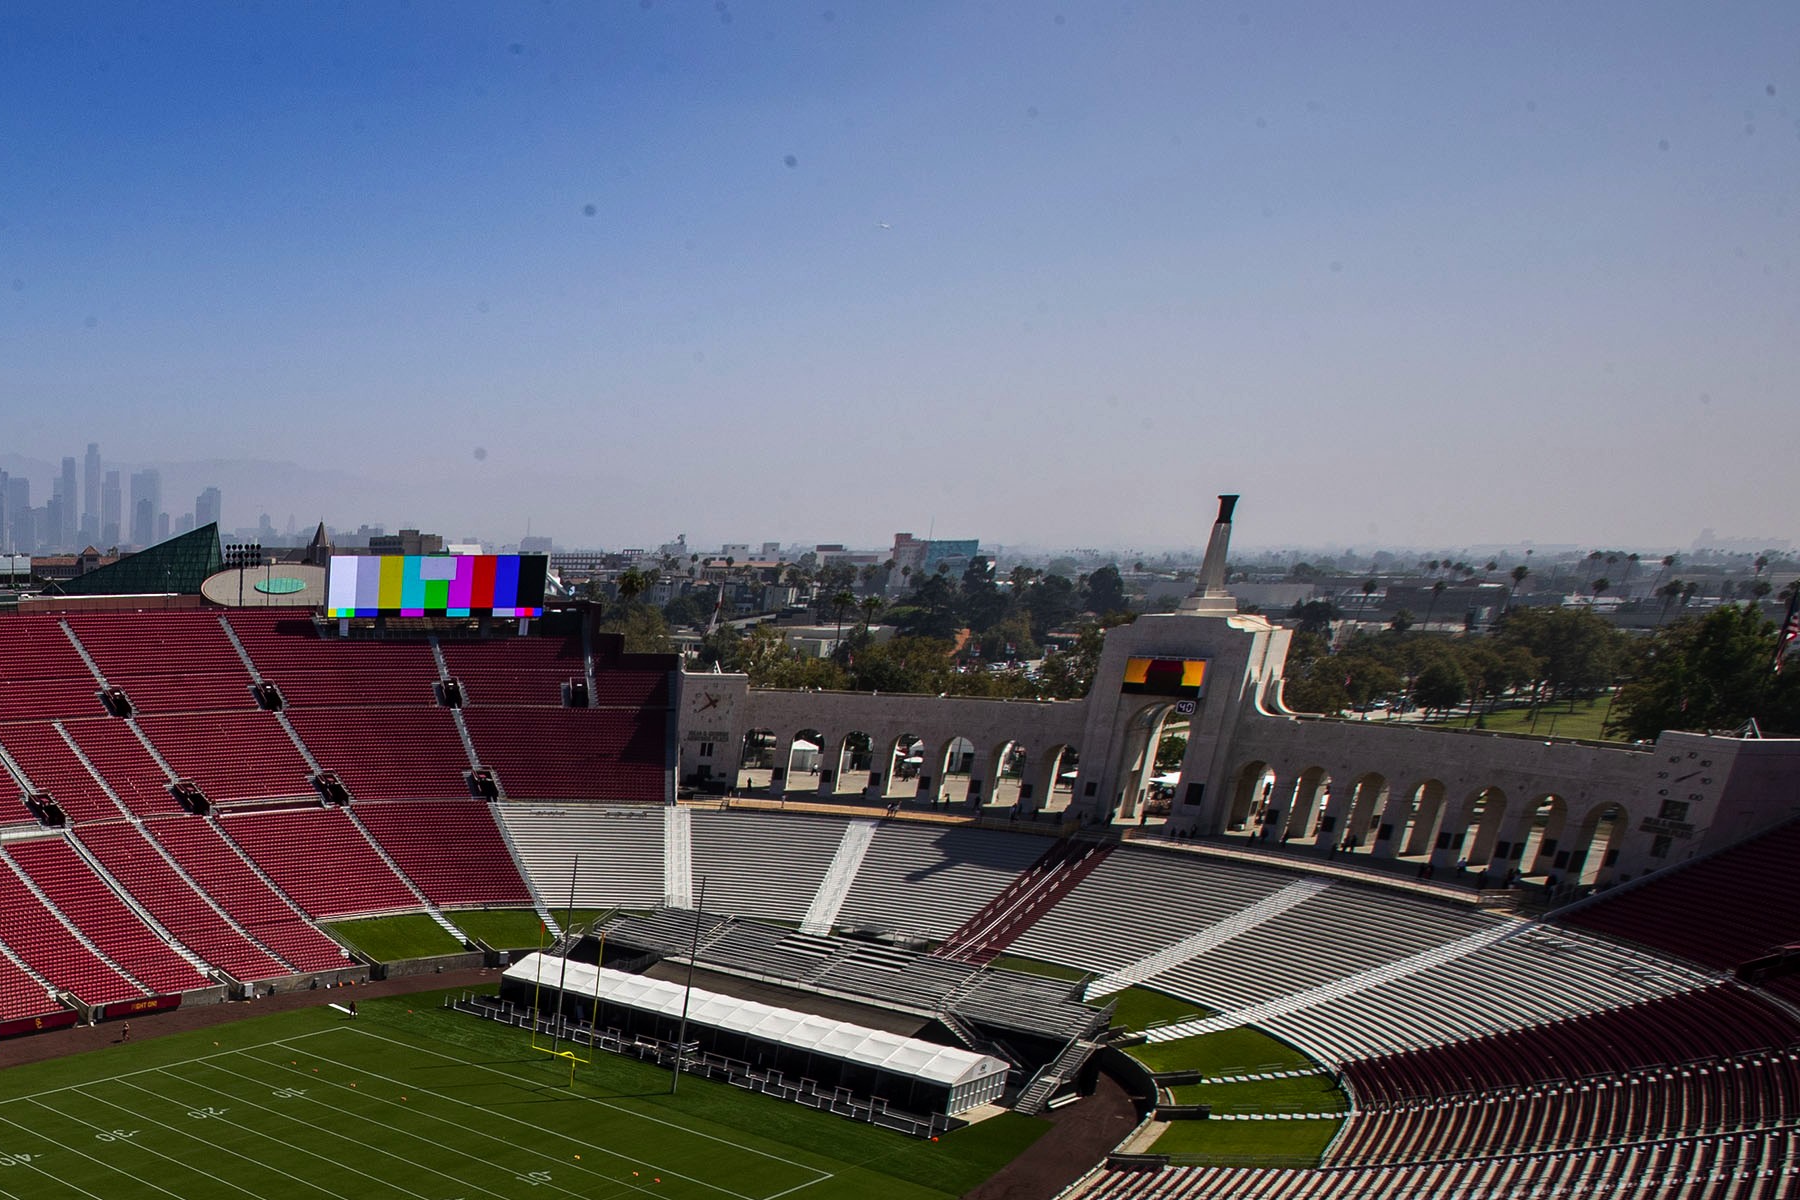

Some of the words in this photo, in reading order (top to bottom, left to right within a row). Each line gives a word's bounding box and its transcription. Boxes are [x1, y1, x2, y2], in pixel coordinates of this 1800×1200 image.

[1179, 702, 1193, 713] 40
[272, 1088, 304, 1098] 10
[187, 1107, 223, 1119] 20
[95, 1129, 132, 1141] 30
